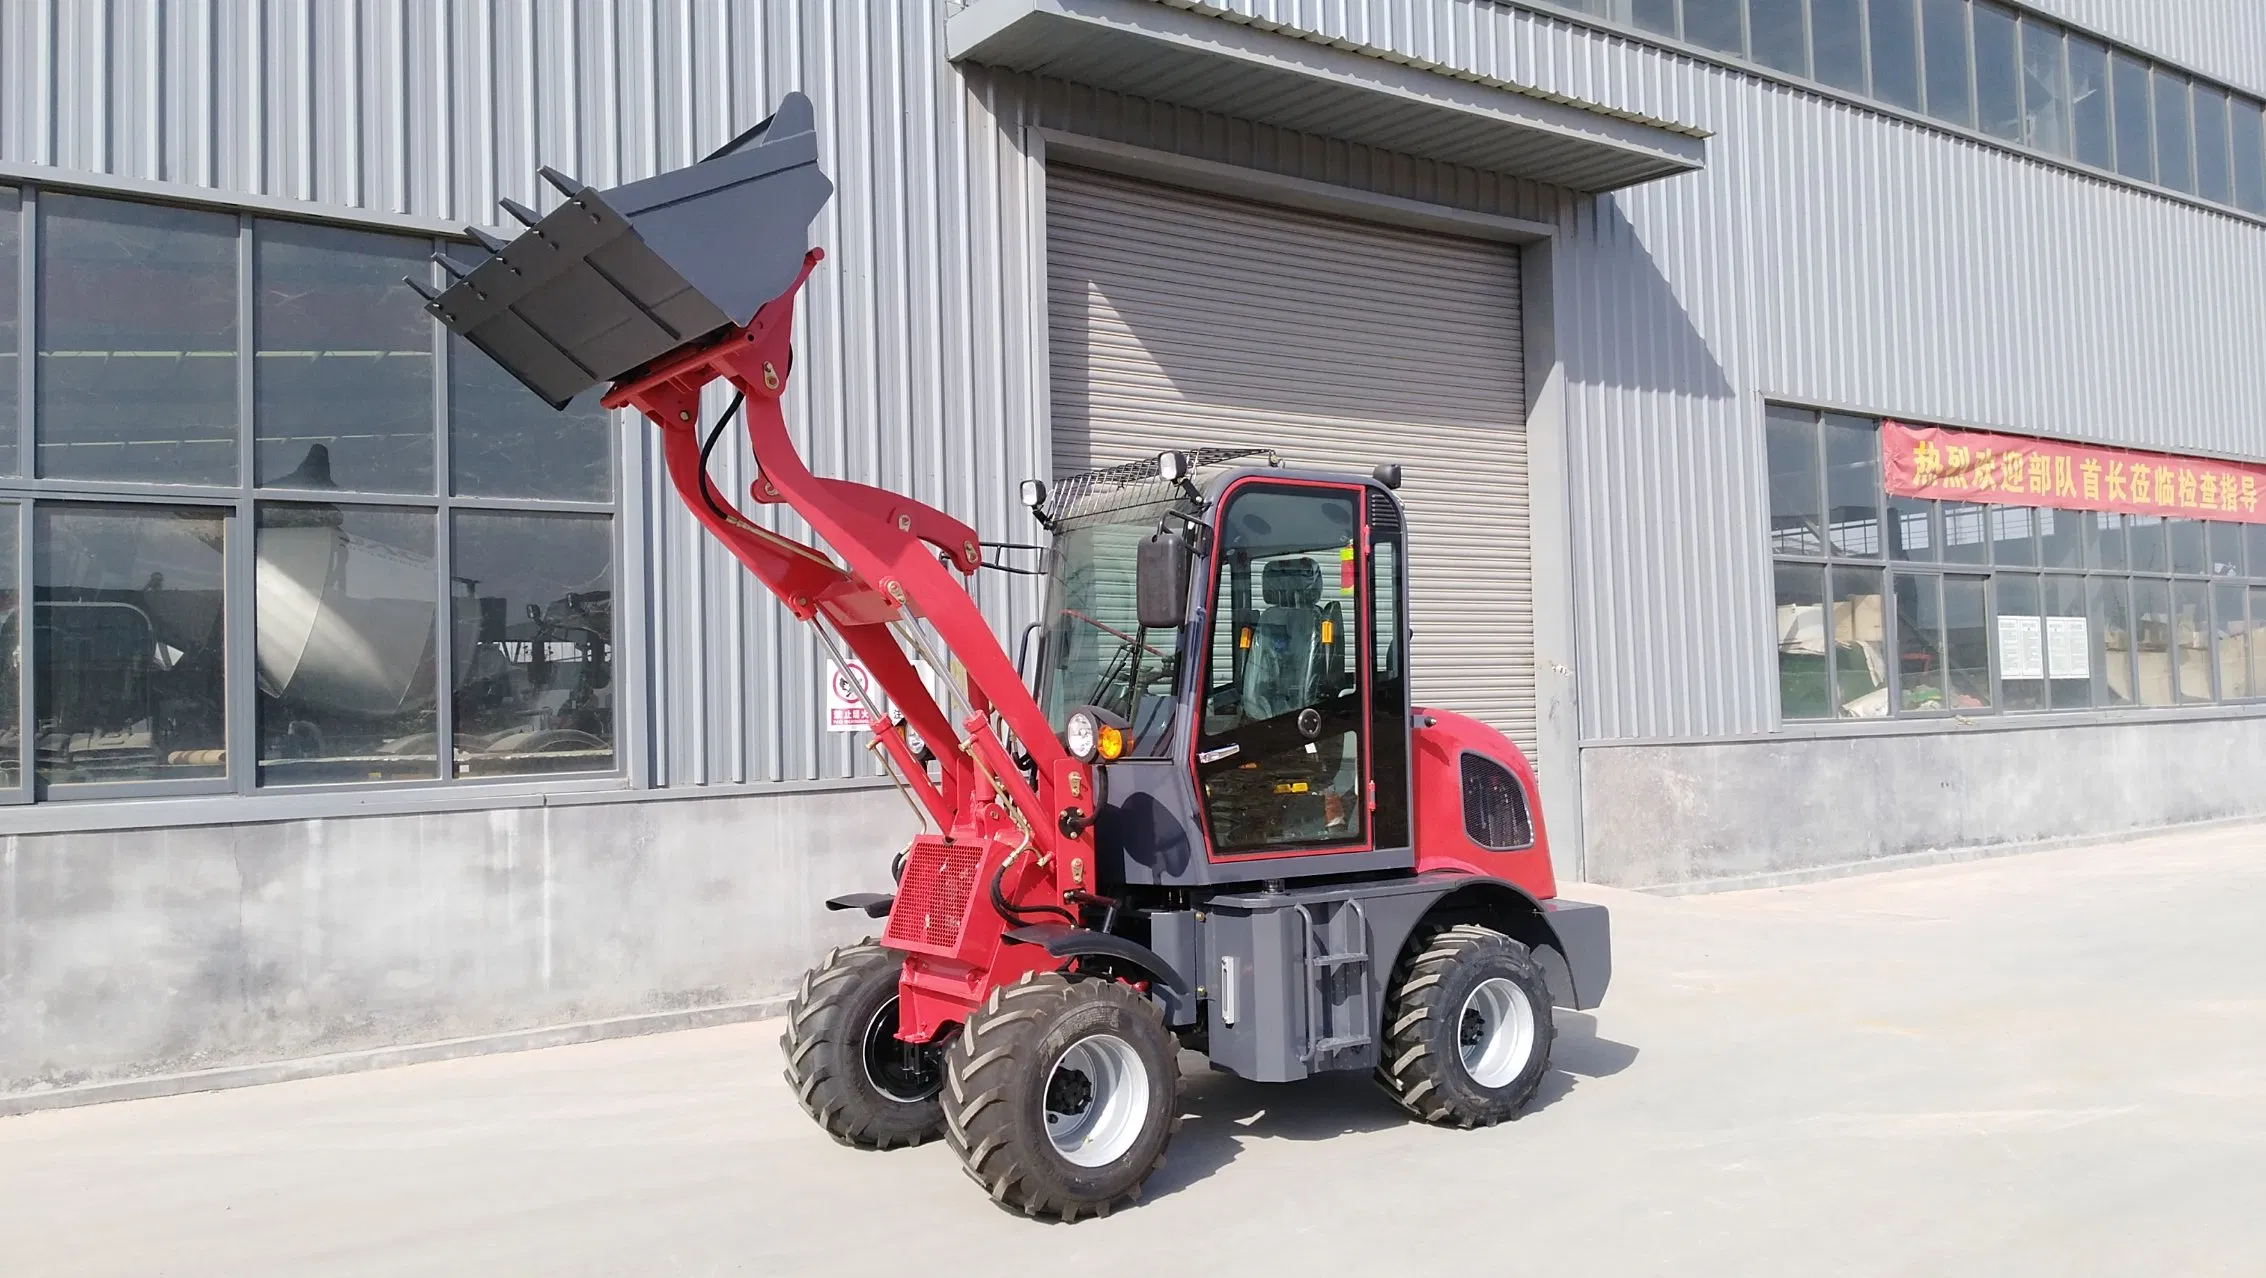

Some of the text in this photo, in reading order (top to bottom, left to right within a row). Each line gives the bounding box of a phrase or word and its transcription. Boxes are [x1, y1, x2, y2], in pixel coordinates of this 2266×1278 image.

[1912, 440, 2258, 513] 热烈欢迎部队首长莅临检查指导
